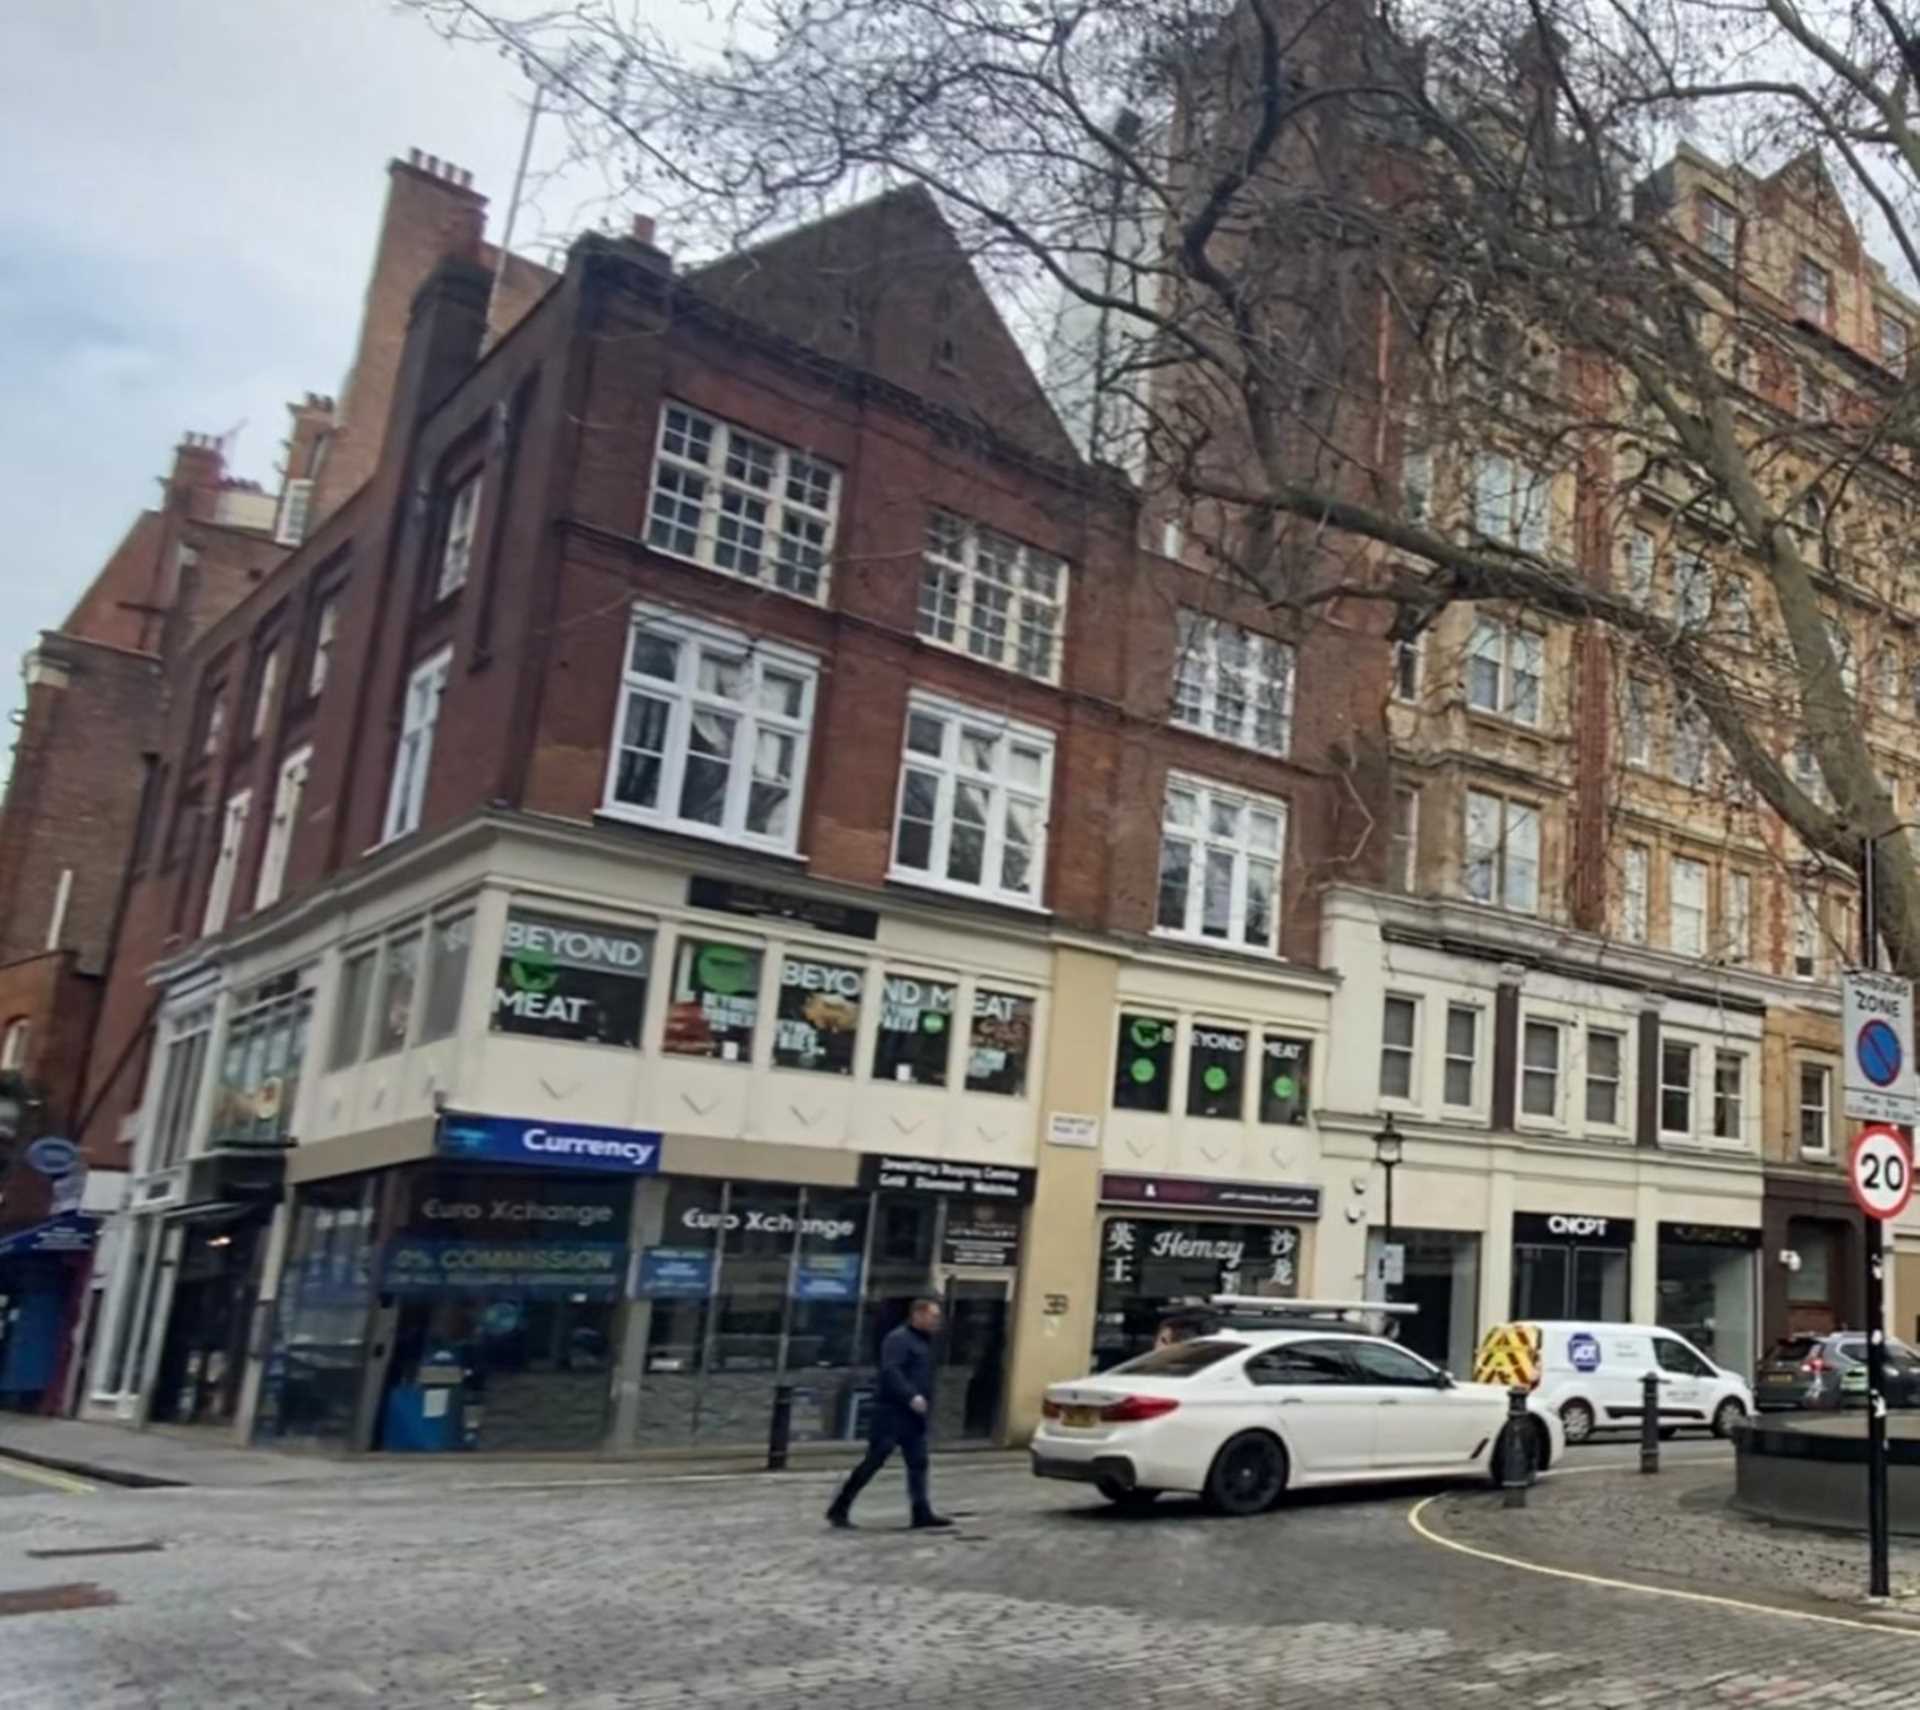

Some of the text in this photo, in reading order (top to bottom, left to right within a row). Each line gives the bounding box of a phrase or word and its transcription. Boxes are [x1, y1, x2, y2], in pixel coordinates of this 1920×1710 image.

[504, 921, 643, 966] BEYOND
[496, 988, 594, 1023] MEAT
[1855, 989, 1900, 1018] ZONE
[522, 1128, 655, 1165] Currency
[1860, 1153, 1904, 1192] 20
[490, 1201, 614, 1227] Xchange
[745, 1211, 855, 1239] Xchange
[1547, 1215, 1608, 1237] CNCPT
[1151, 1231, 1247, 1269] Hemzy
